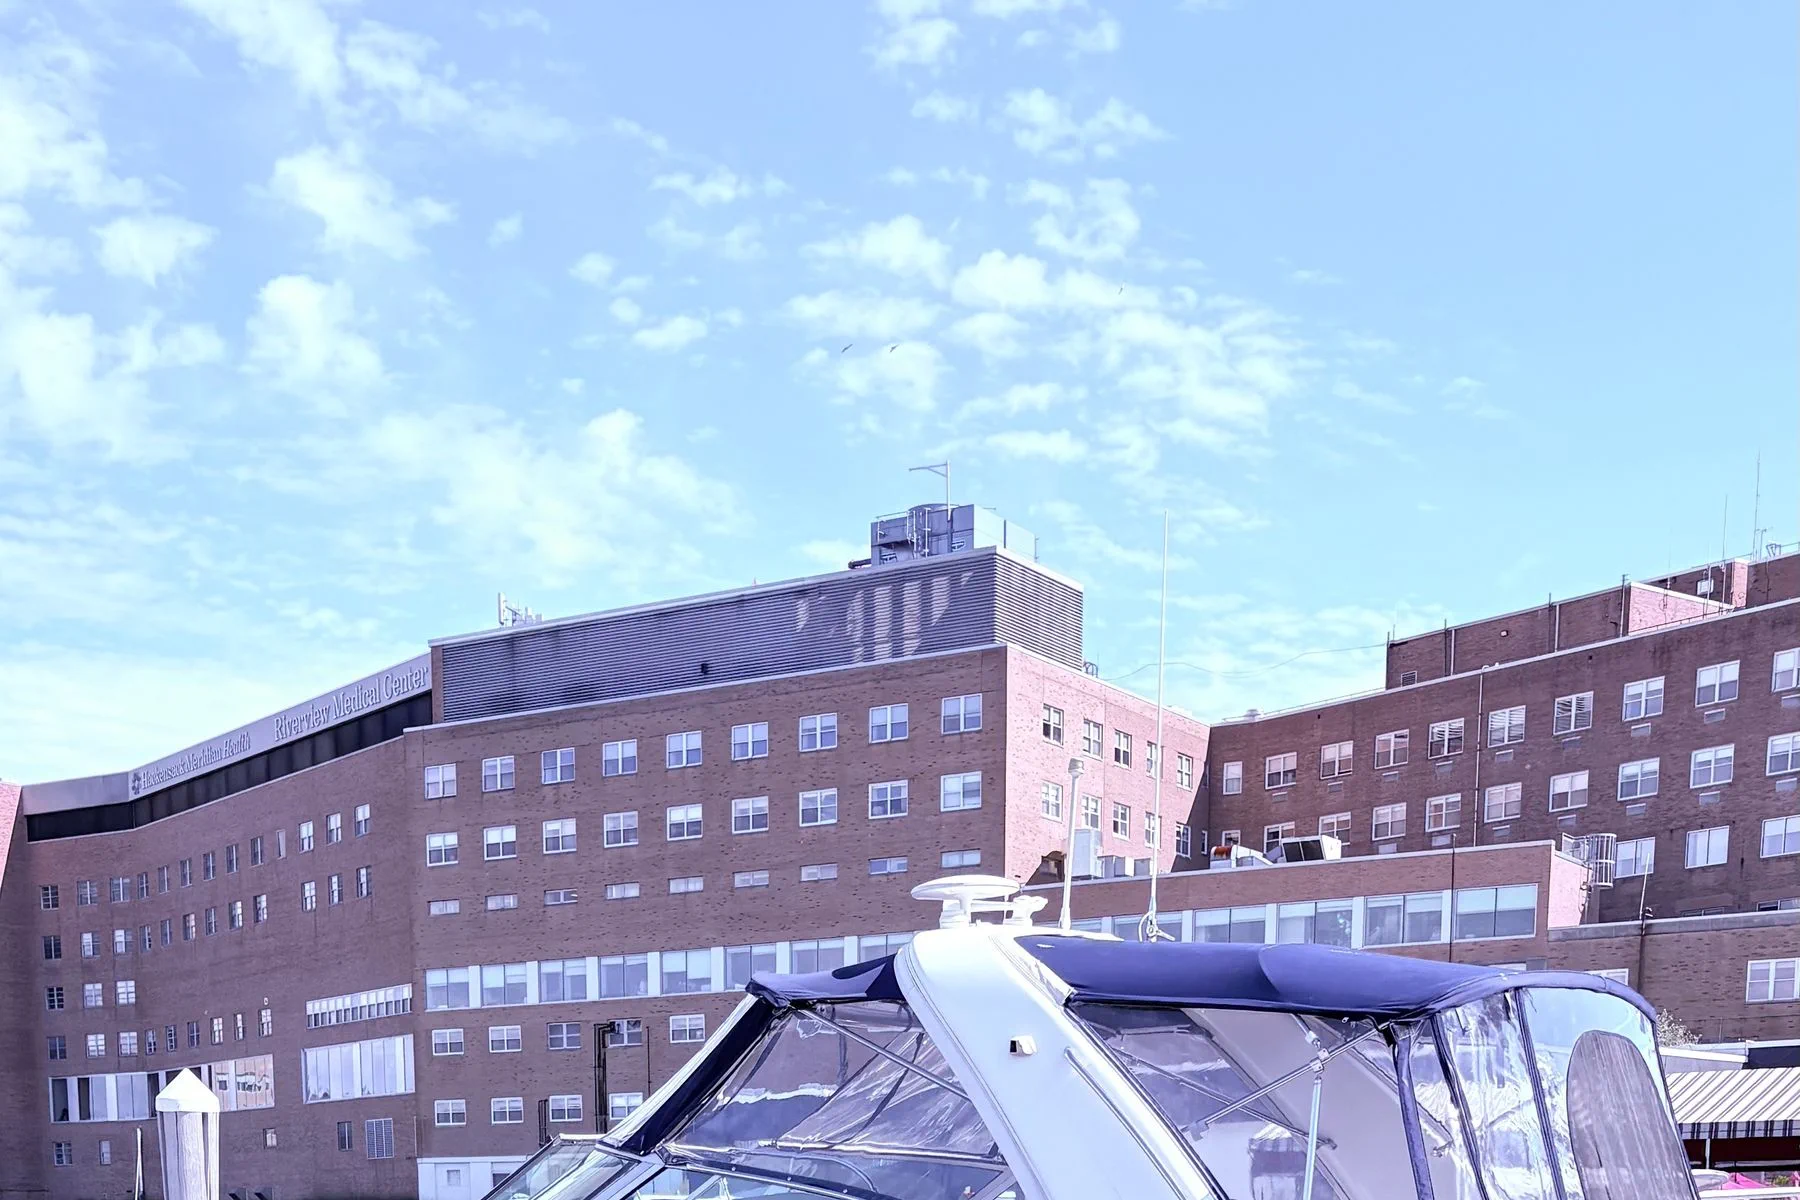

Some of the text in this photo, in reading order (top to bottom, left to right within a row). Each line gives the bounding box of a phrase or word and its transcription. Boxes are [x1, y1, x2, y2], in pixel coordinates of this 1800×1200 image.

[274, 665, 429, 741] Riverview Medical Center
[141, 732, 251, 789] Hackensack Meridian Health
